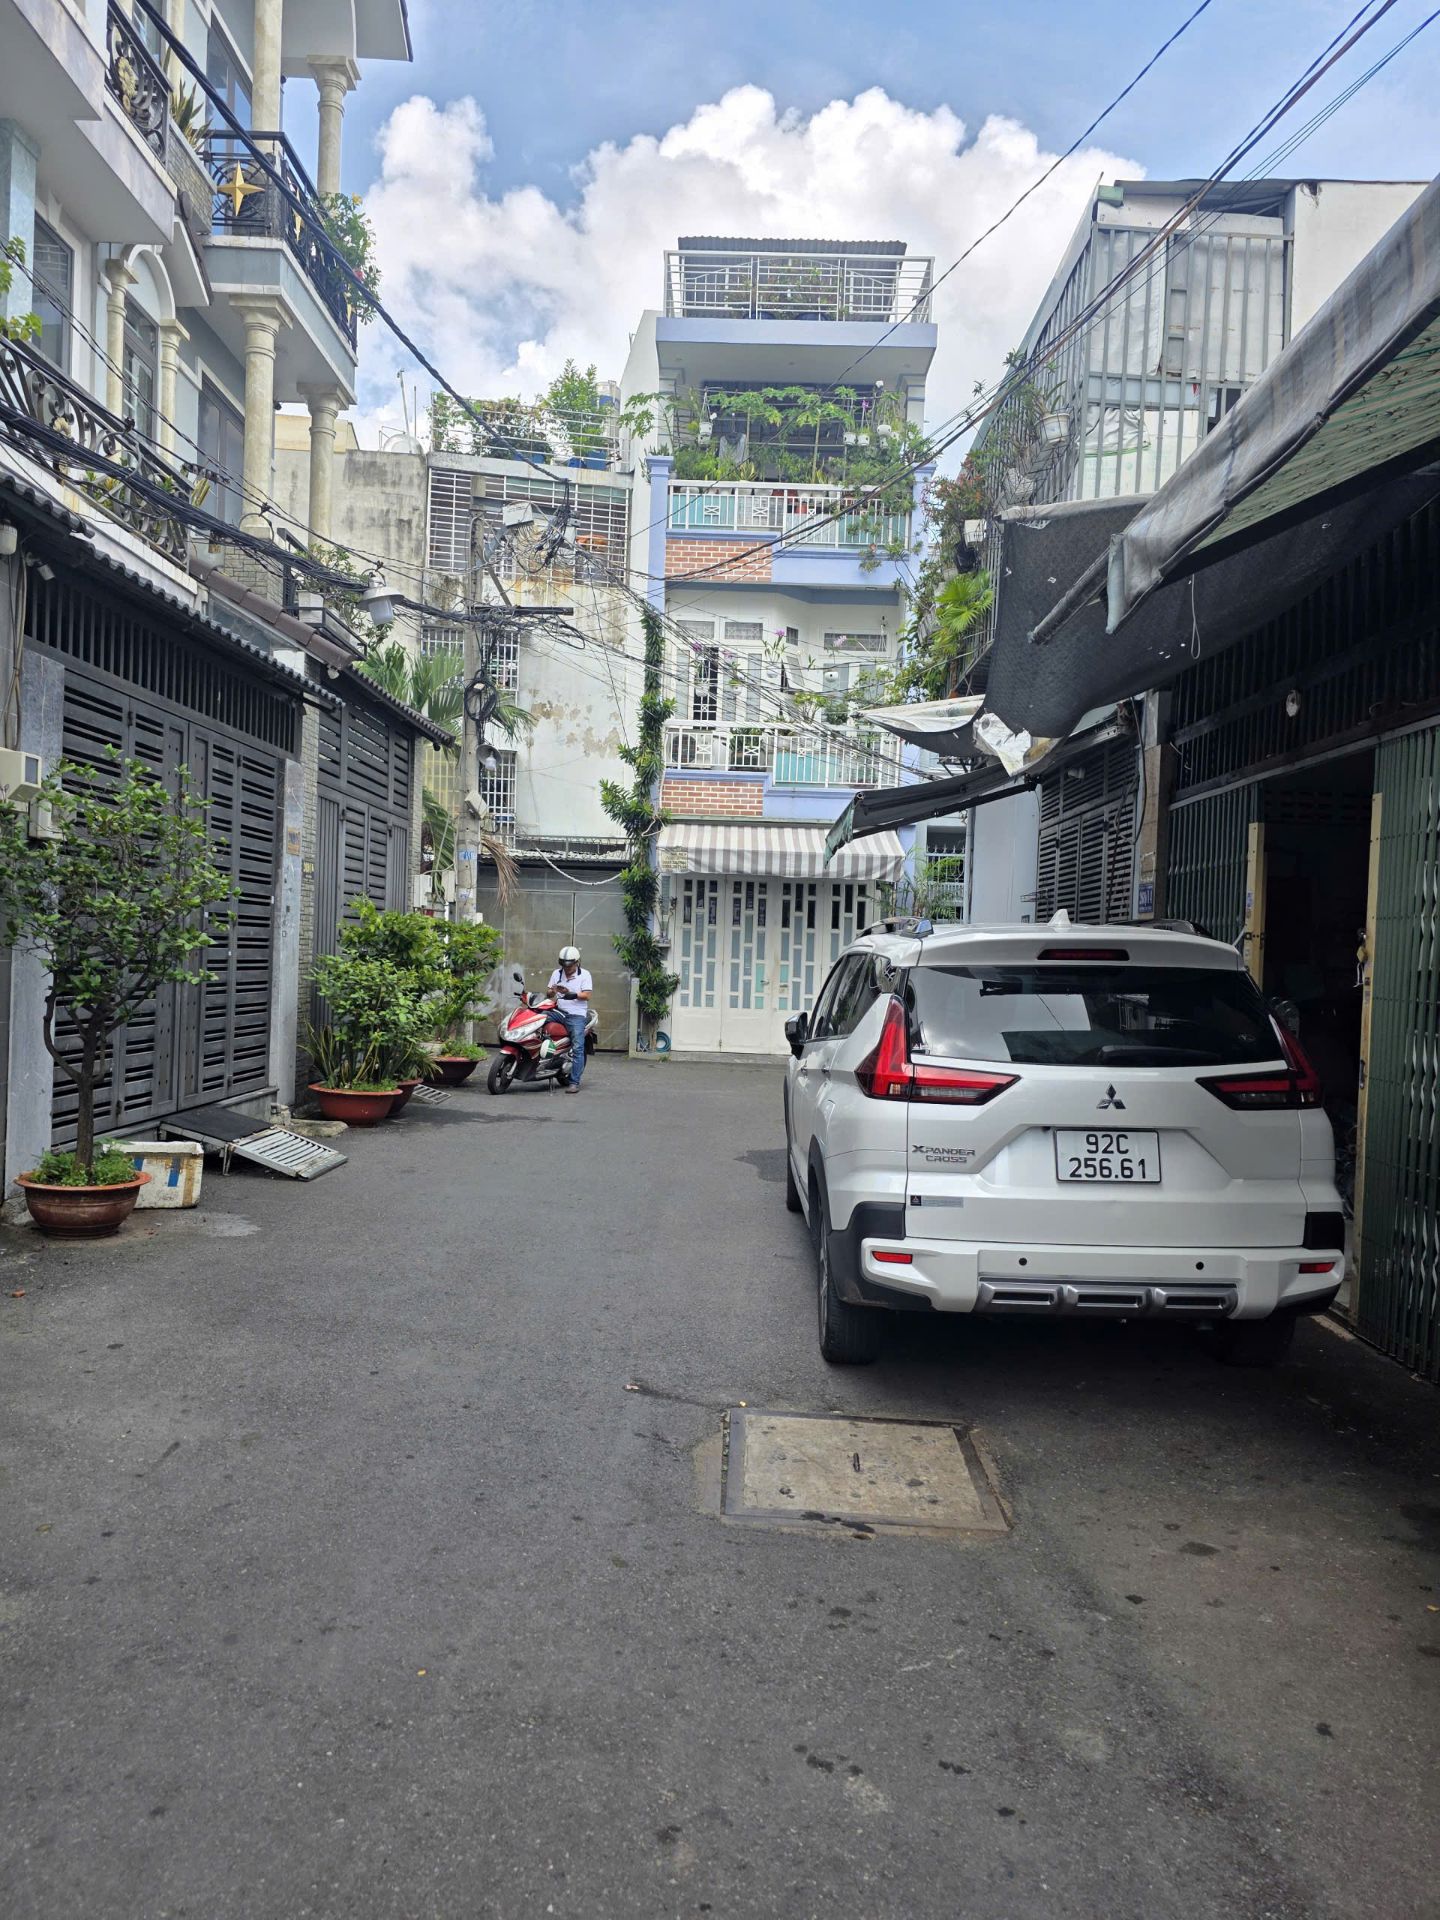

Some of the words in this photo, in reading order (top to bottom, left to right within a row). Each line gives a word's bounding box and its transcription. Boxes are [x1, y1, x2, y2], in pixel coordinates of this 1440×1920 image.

[911, 1144, 976, 1157] XPANDER
[1085, 1133, 1129, 1155] 92C
[925, 1154, 967, 1164] CROSS
[1068, 1157, 1147, 1179] 256.61
